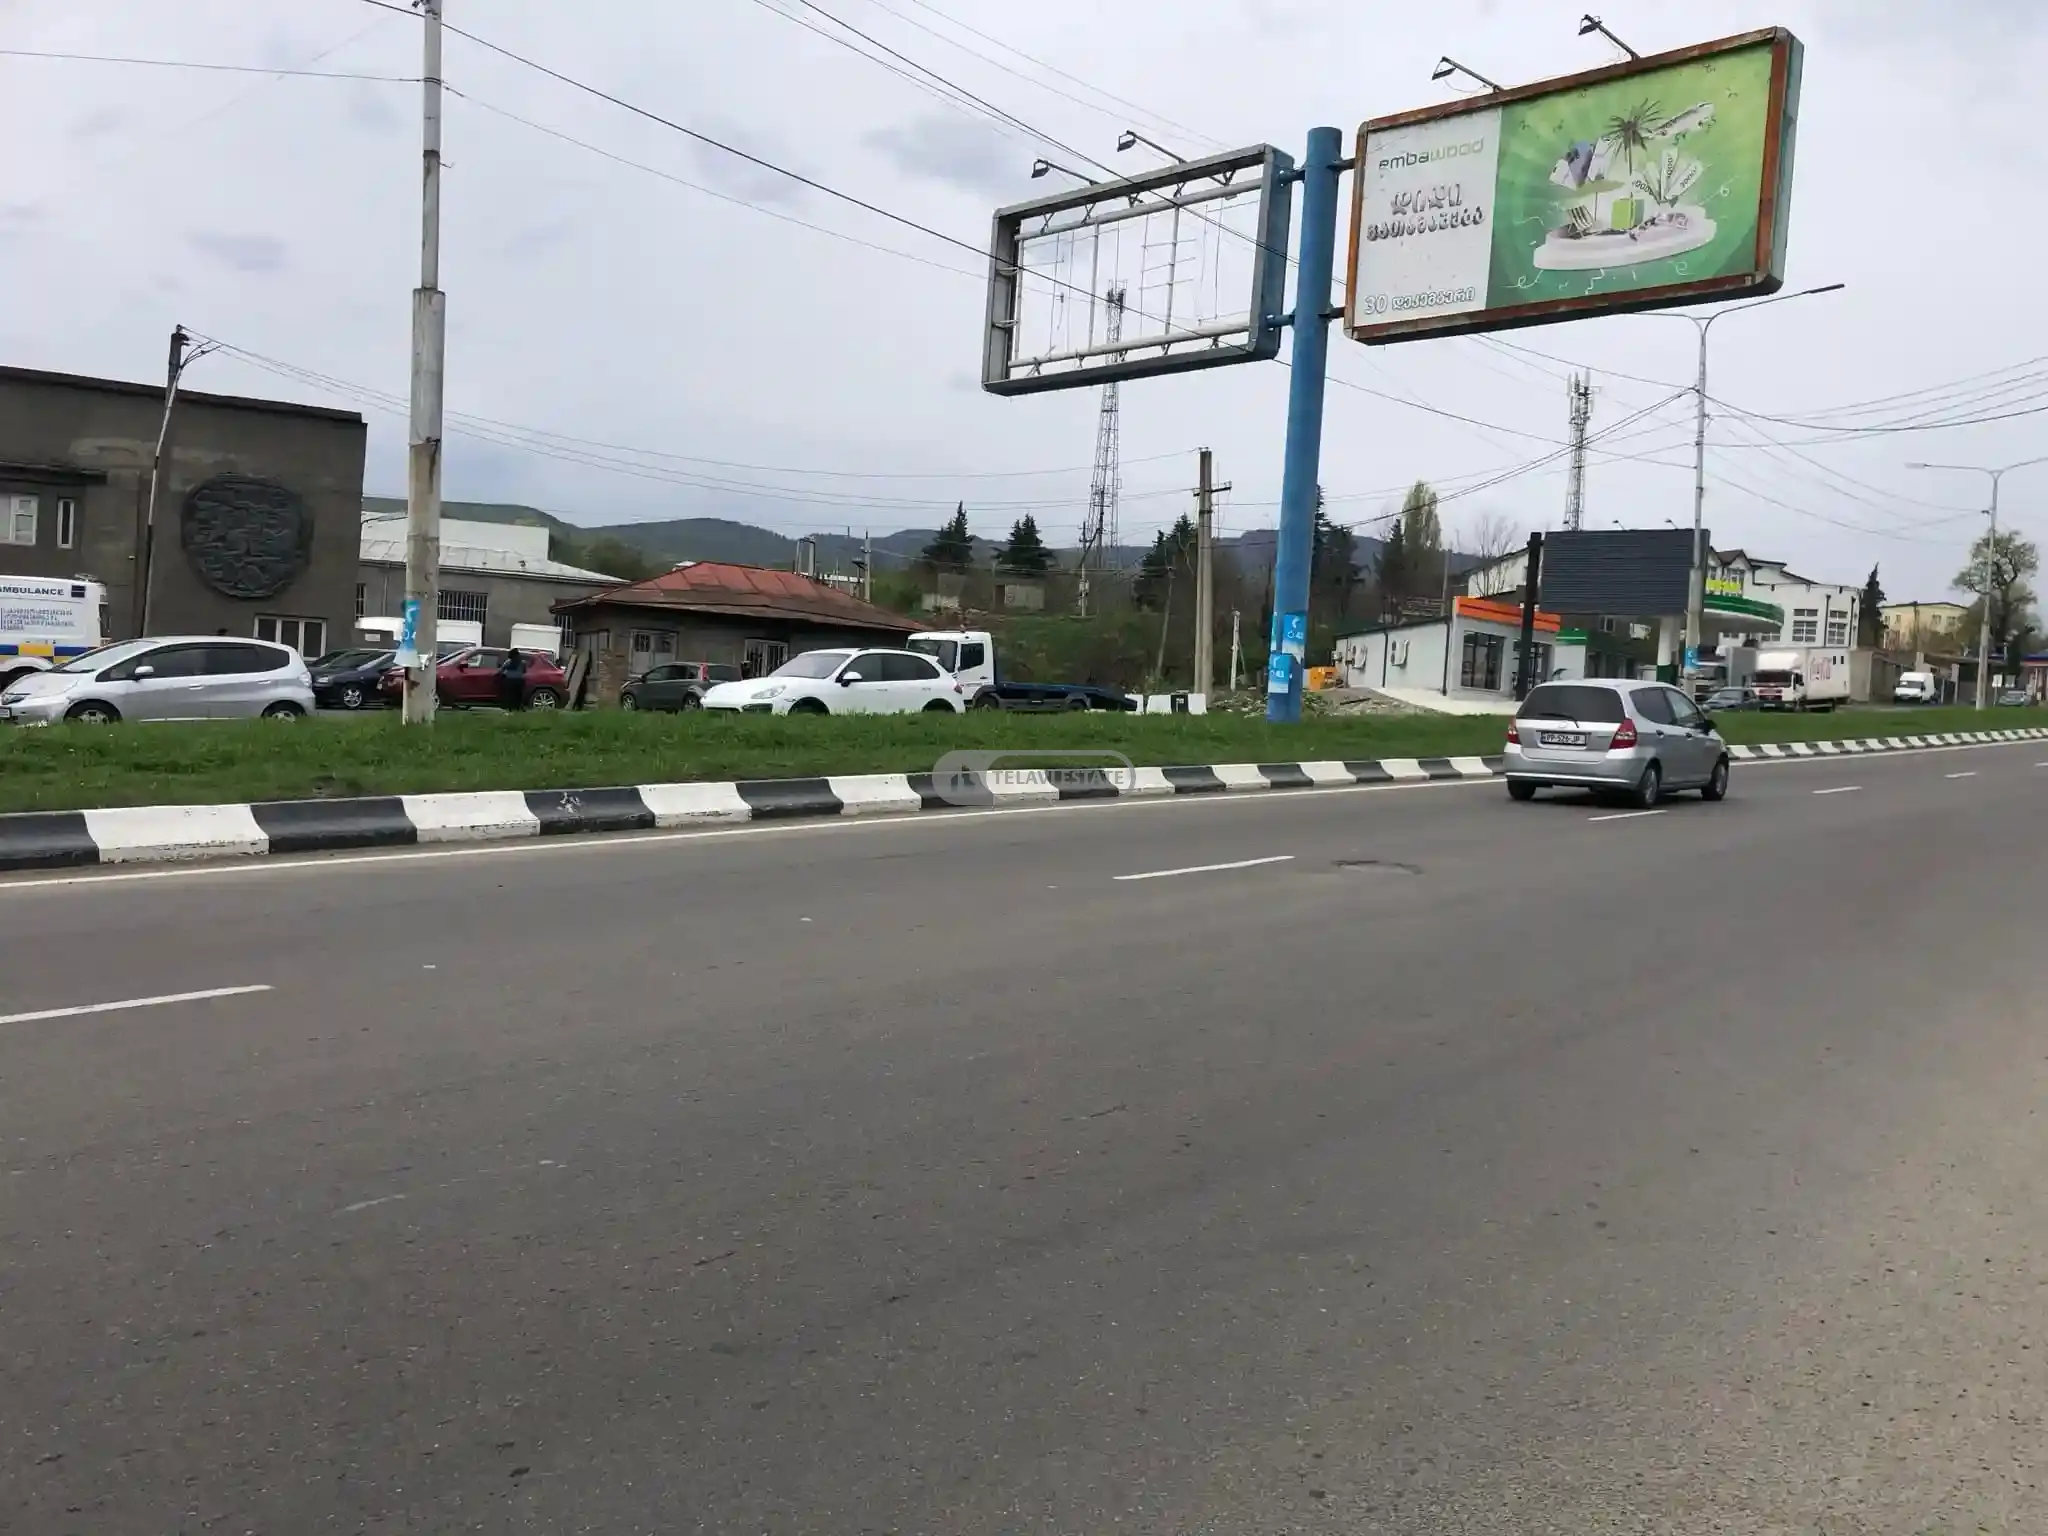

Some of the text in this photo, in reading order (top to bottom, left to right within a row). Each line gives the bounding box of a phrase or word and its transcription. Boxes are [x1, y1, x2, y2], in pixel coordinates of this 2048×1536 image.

[1379, 137, 1484, 169] embawood
[1364, 294, 1388, 315] 30
[0, 586, 64, 596] MBULANCE
